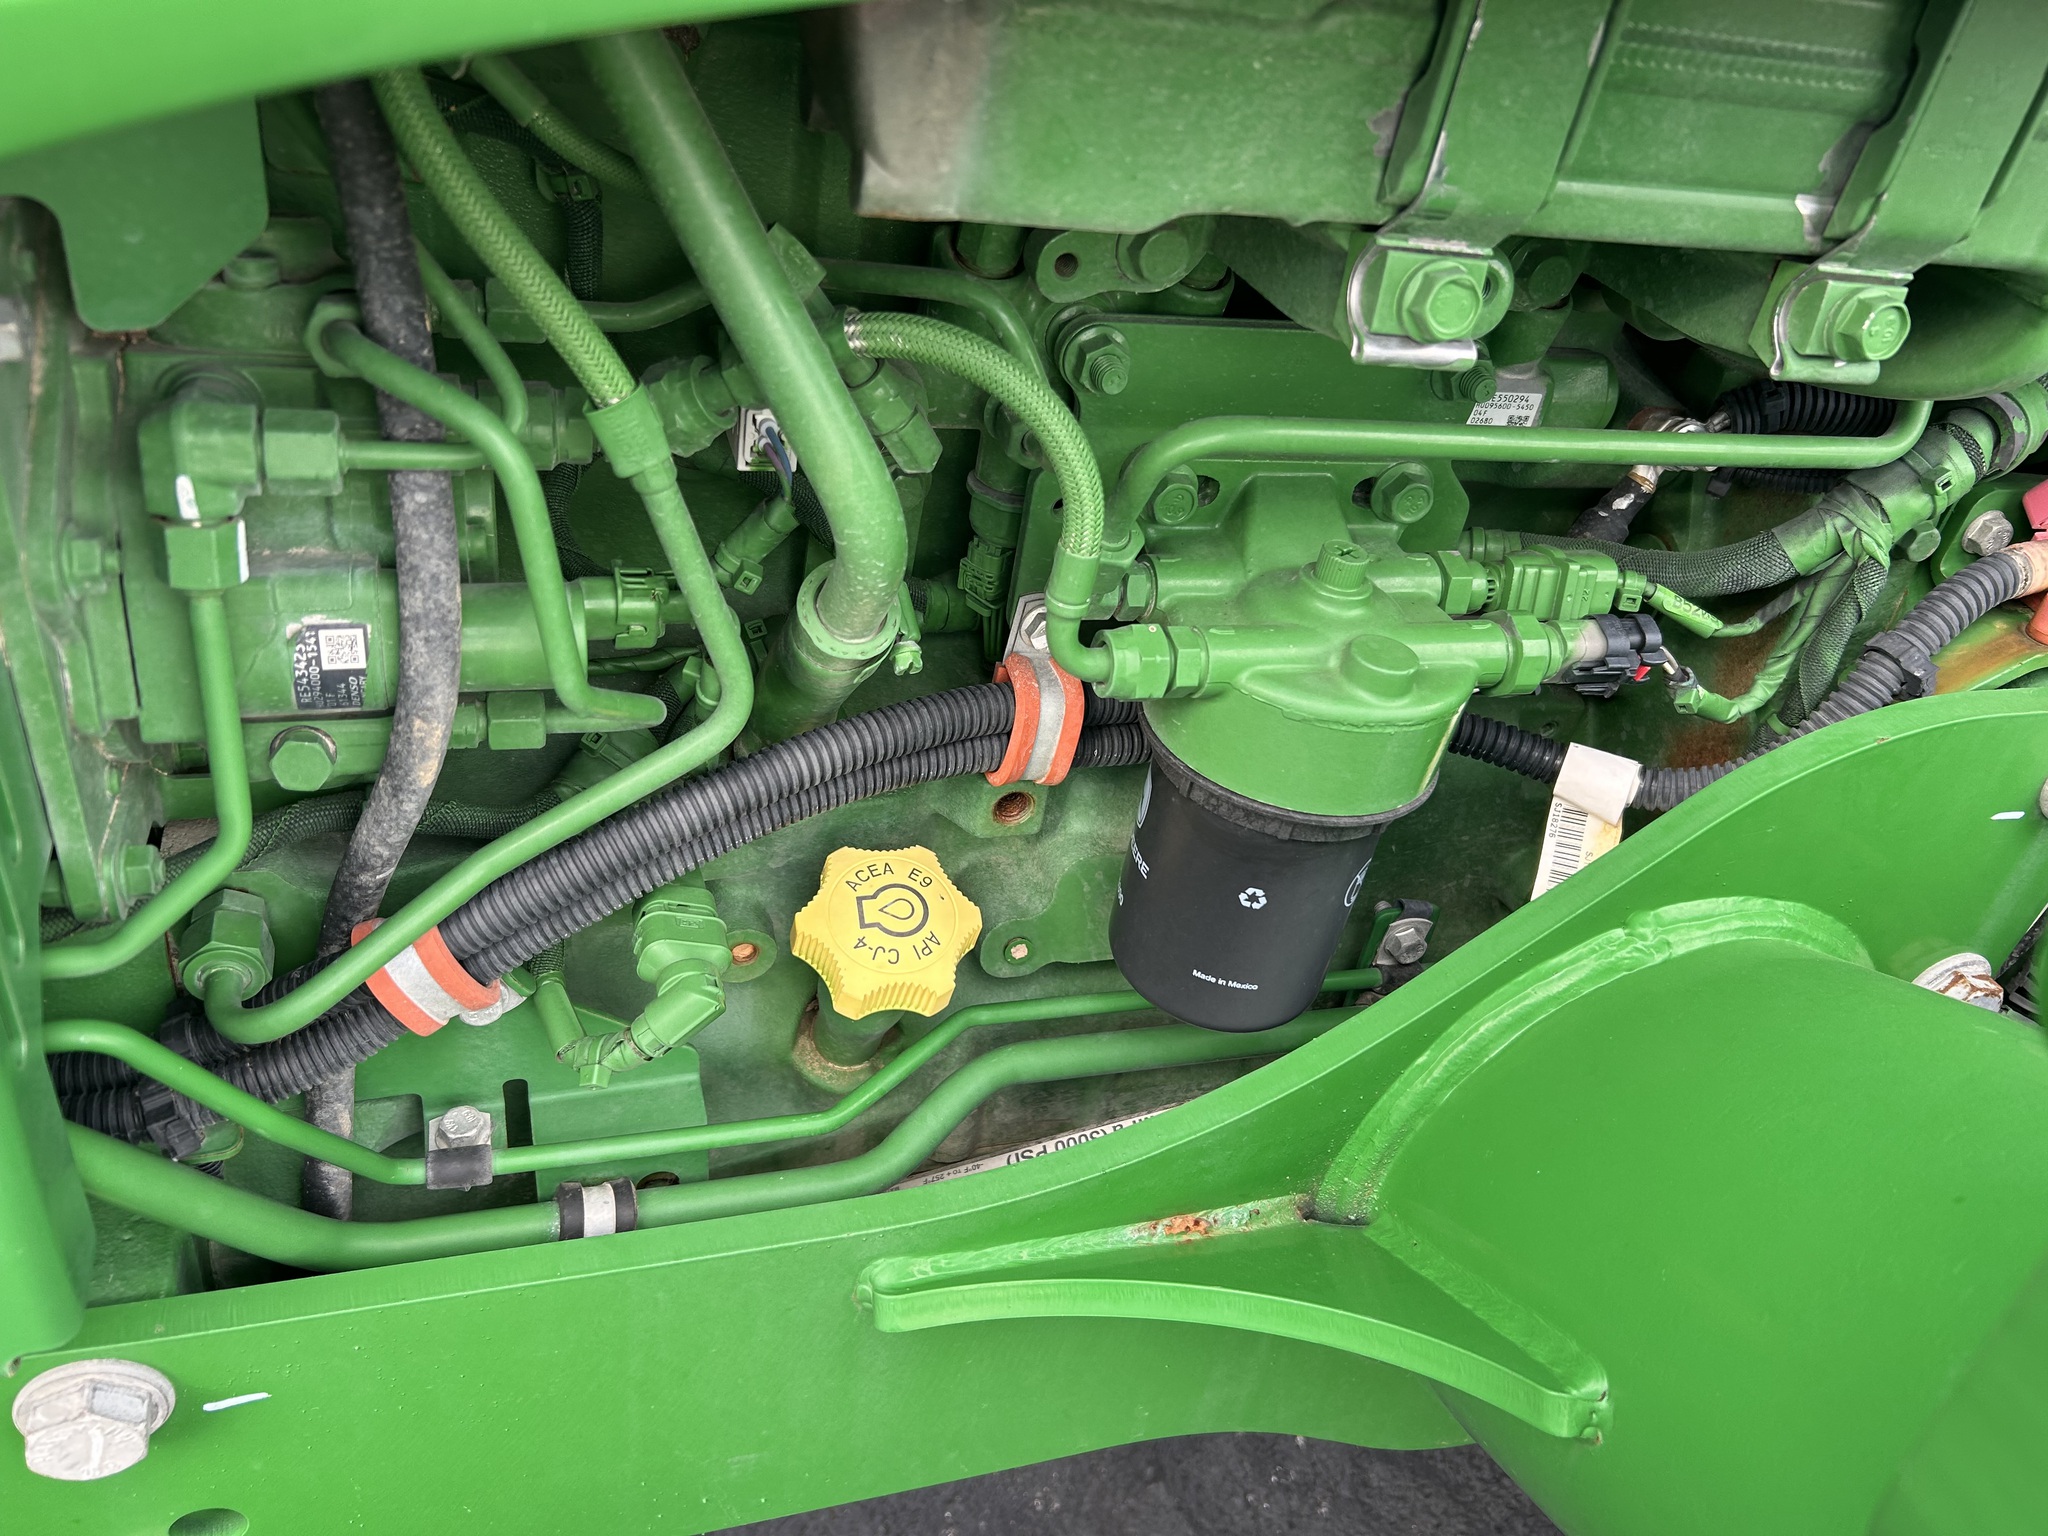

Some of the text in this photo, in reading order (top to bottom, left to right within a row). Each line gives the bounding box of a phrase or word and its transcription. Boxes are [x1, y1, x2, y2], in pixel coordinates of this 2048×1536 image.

[1491, 394, 1530, 403] E550294
[348, 676, 361, 706] DENSO
[1548, 802, 1563, 838] SJ18276
[845, 862, 934, 892] ACEA E9
[853, 931, 941, 965] API CJ-4
[1192, 969, 1259, 991] Made in Mexico
